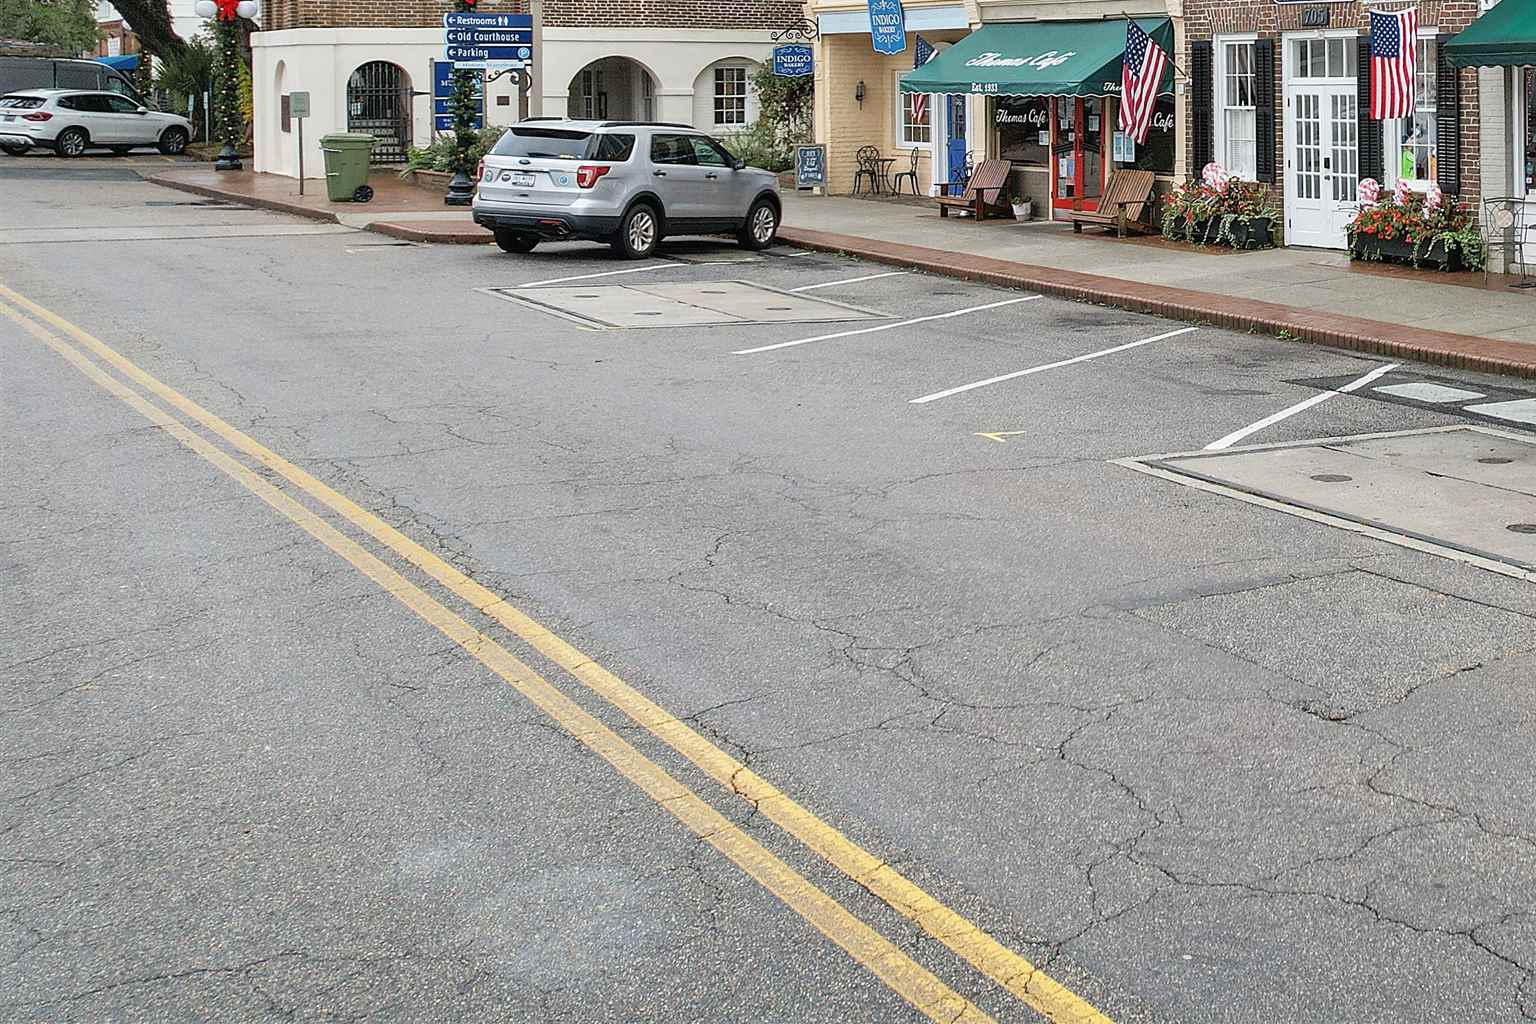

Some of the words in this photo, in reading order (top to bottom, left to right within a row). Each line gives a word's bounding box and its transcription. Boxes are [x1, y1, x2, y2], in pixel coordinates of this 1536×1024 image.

[457, 16, 497, 25] Restrooms
[872, 14, 900, 25] INDIGO
[457, 32, 471, 41] Old
[474, 32, 520, 42] Courthouse
[457, 48, 489, 58] Parking
[776, 55, 811, 63] INDIGO
[965, 52, 1028, 68] Thomas
[971, 82, 983, 92] Est.
[984, 82, 998, 93] 1933
[996, 109, 1027, 123] Thomas
[1028, 109, 1046, 127] Café
[1154, 112, 1174, 132] Café
